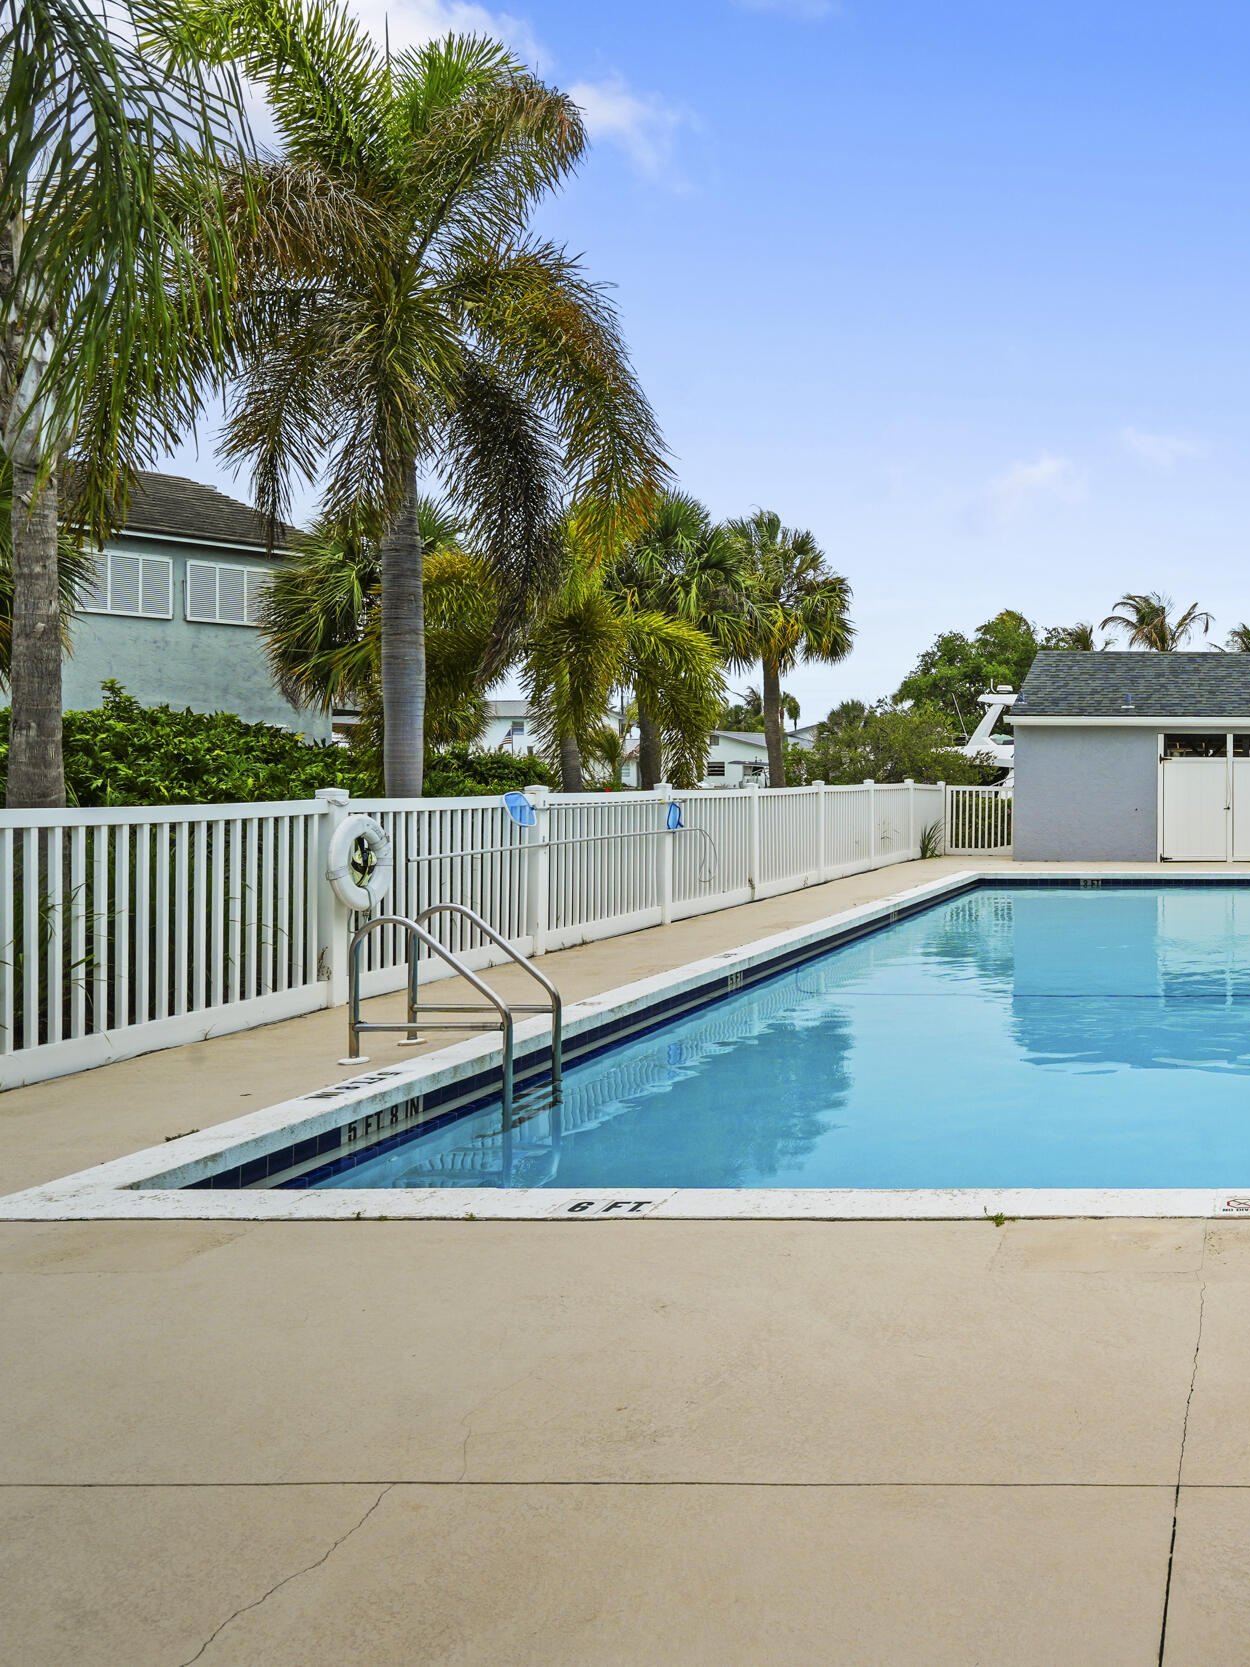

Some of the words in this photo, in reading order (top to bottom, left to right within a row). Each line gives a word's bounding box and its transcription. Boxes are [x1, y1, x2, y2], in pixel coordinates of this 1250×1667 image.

[348, 1120, 358, 1143] 5
[390, 1104, 399, 1125] 8
[567, 1201, 595, 1213] 6
